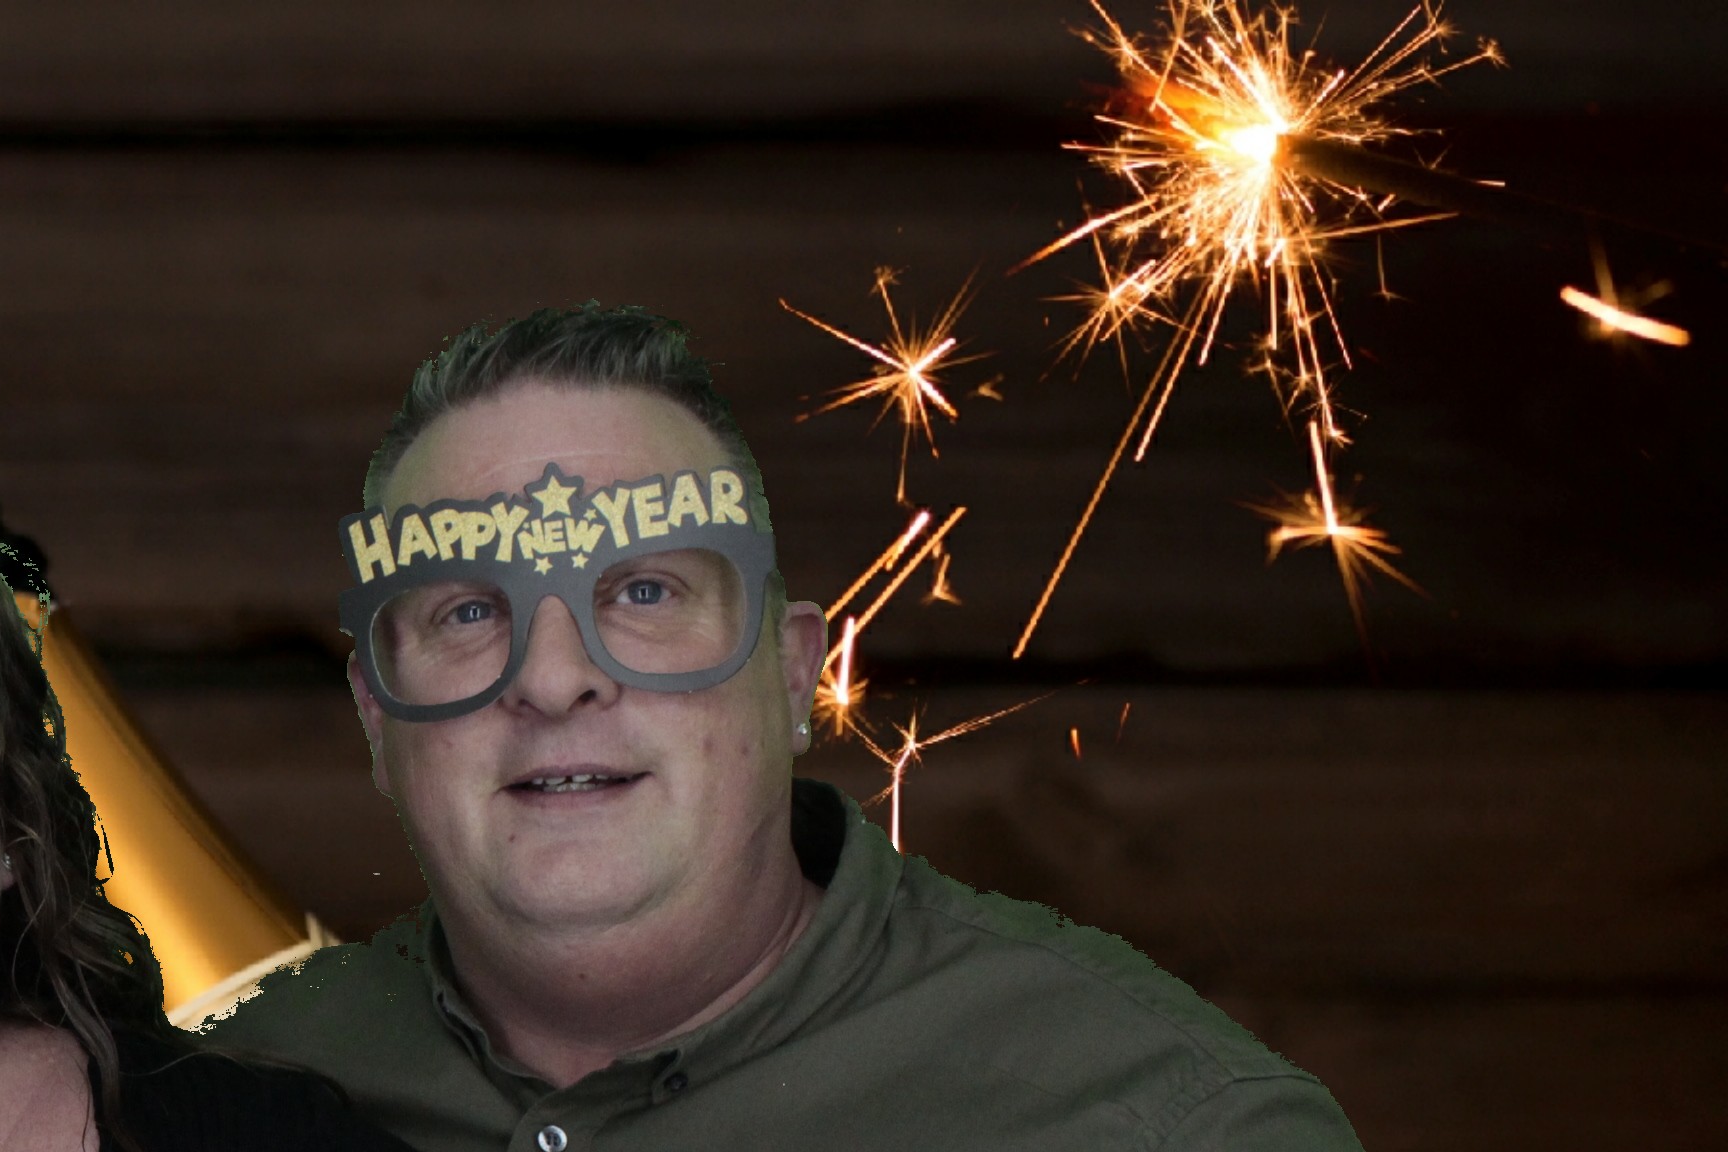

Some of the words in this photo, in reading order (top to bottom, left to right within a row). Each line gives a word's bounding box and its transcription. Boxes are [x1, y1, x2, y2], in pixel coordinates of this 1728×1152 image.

[347, 501, 530, 584] HAPPY
[517, 516, 606, 560] NEW
[592, 469, 748, 549] YEAR
